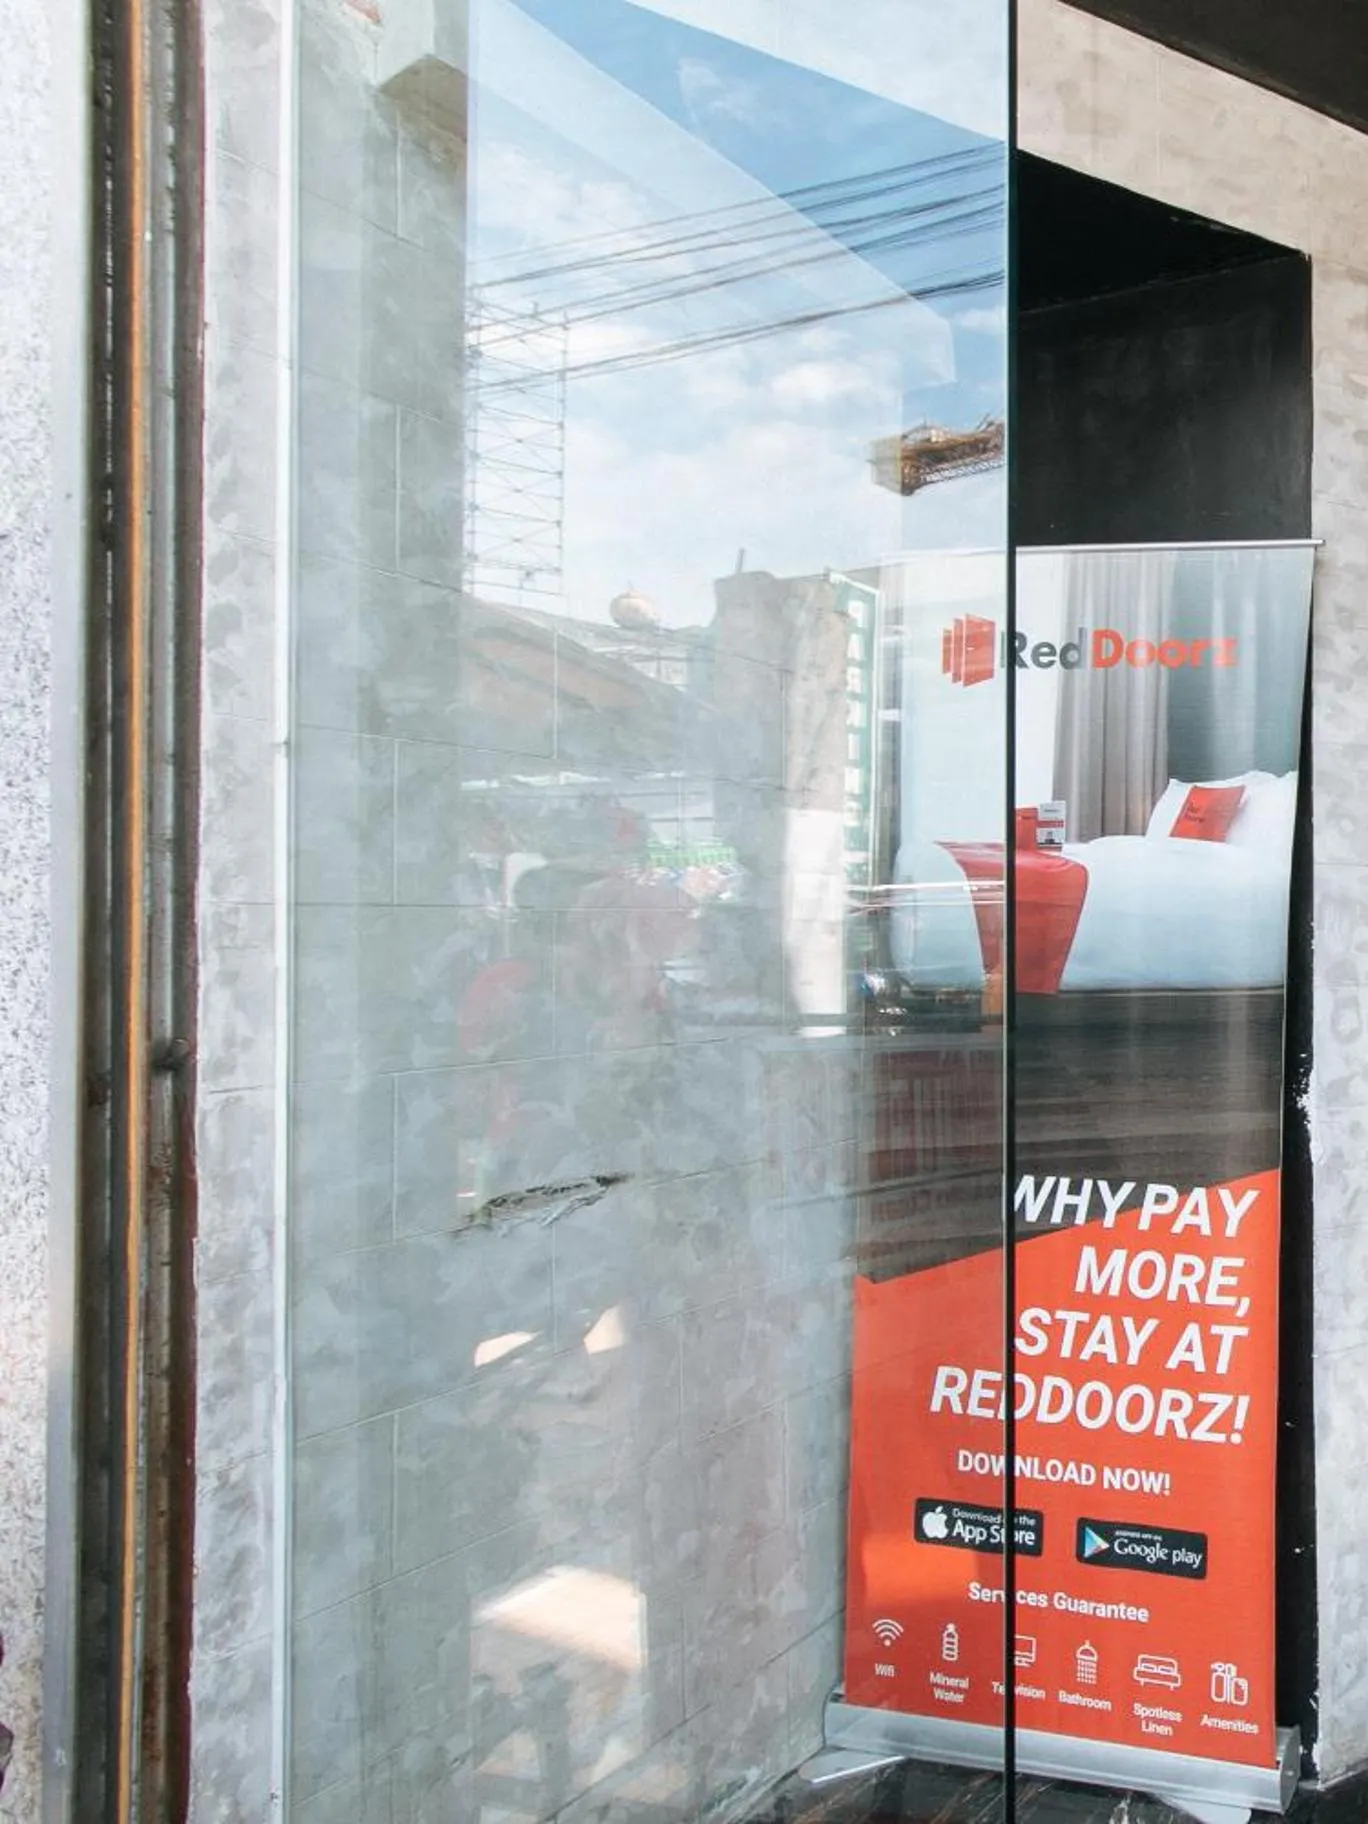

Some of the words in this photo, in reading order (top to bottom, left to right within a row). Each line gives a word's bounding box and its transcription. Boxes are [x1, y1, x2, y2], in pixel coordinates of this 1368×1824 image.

[1014, 1174, 1136, 1228] WHY
[1138, 1183, 1261, 1238] PAY
[1074, 1245, 1251, 1318] MORE,
[1014, 1307, 1159, 1366] STAY
[1165, 1322, 1249, 1375] AT
[930, 1365, 1250, 1444] REDDOORZ!
[1103, 1466, 1171, 1496] NOW!
[952, 1519, 987, 1545] App
[1019, 1515, 1036, 1526] the
[1114, 1538, 1169, 1564] Google
[1172, 1547, 1203, 1568] play
[968, 1581, 1048, 1608] Serces
[1053, 1592, 1149, 1623] Guarantee
[929, 1671, 969, 1690] Mineral
[991, 1681, 1046, 1699] Tevision
[934, 1687, 965, 1703] Water
[1058, 1690, 1112, 1711] Bathroom
[1133, 1702, 1183, 1723] Spotless
[1200, 1714, 1259, 1734] Amenities
[1141, 1719, 1173, 1736] Linen
